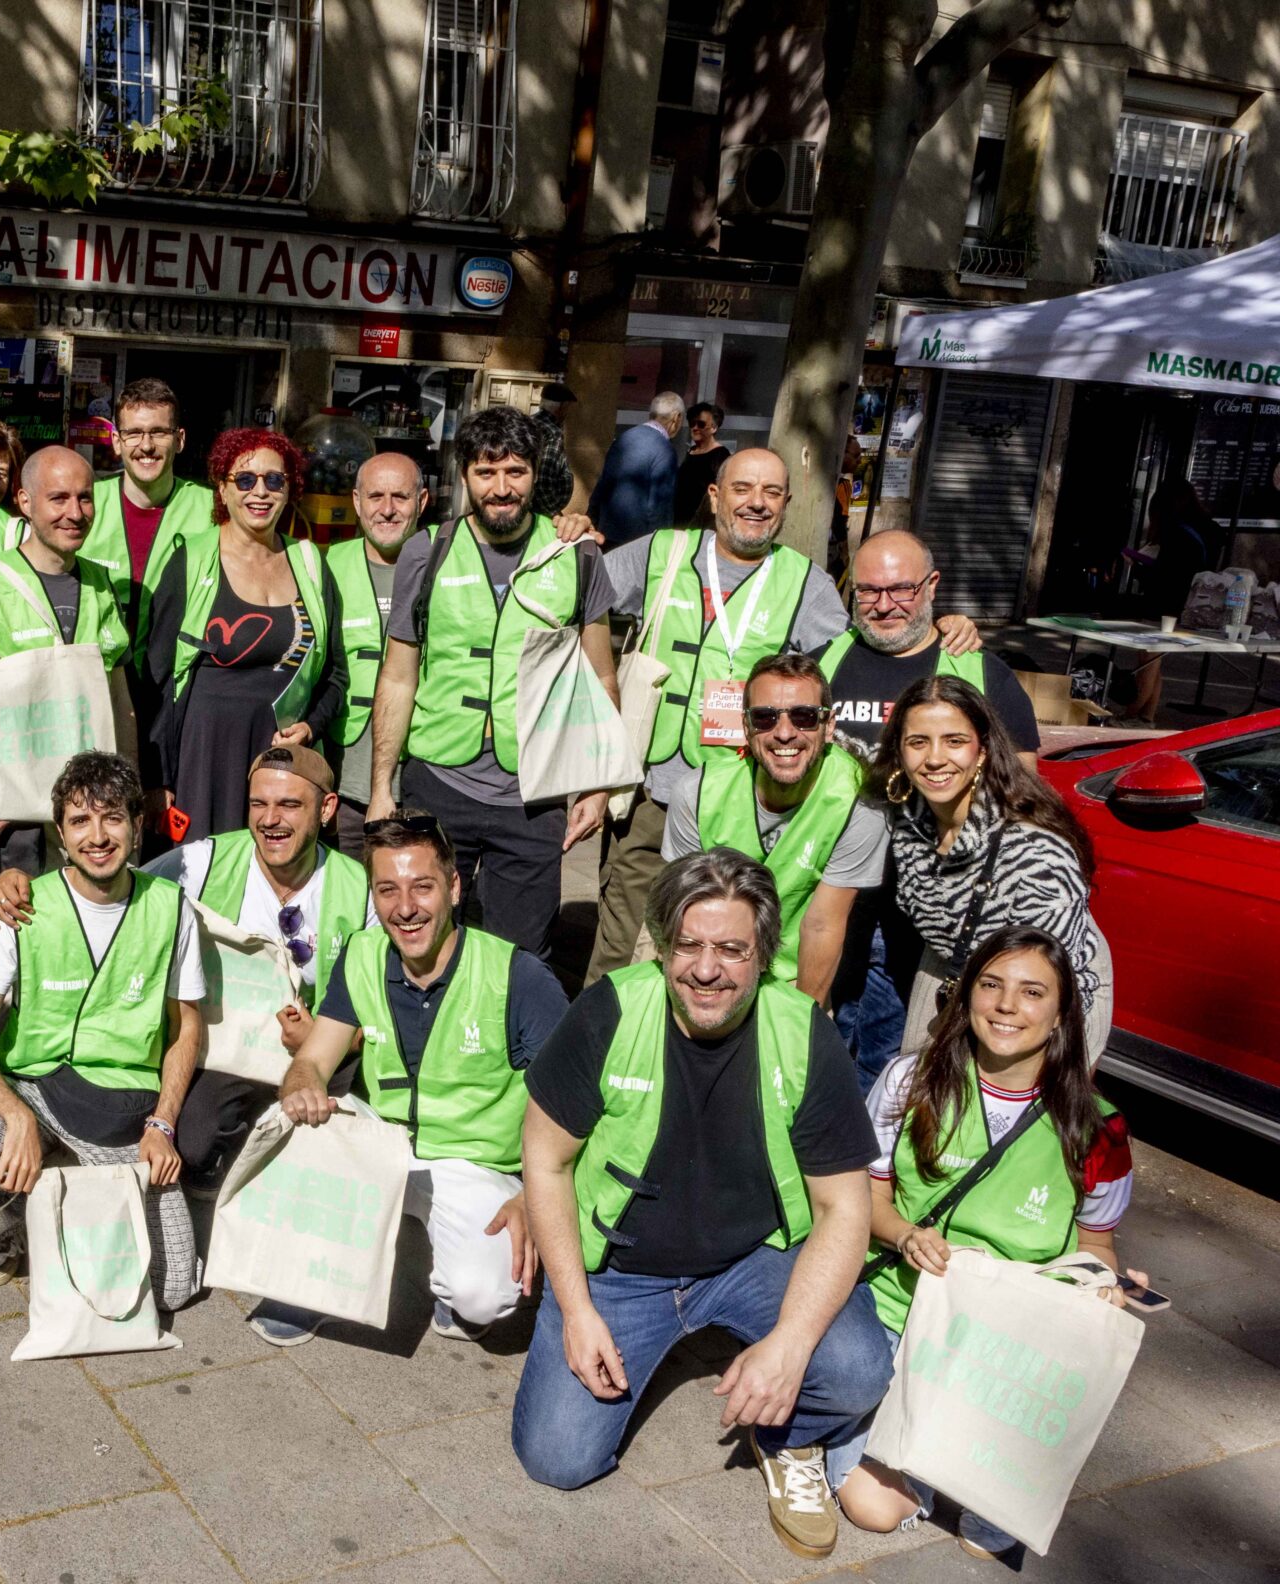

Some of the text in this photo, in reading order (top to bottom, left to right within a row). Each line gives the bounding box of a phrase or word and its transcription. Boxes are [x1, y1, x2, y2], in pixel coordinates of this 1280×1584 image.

[38, 291, 292, 340] DESPACHO DE PAN
[708, 298, 729, 318] 22
[363, 329, 397, 340] ENERYETI
[944, 340, 966, 352] Más
[940, 353, 977, 364] Madrid
[254, 408, 274, 424] Fini
[712, 692, 742, 701] Puerta
[459, 1046, 486, 1054] Madrid
[1015, 1206, 1047, 1225] Madrid
[1023, 1202, 1043, 1215] Más
[273, 1195, 377, 1249] PUEBLO
[945, 1312, 1086, 1410] ORGULLO
[909, 1338, 1069, 1448] DE PUEBLO
